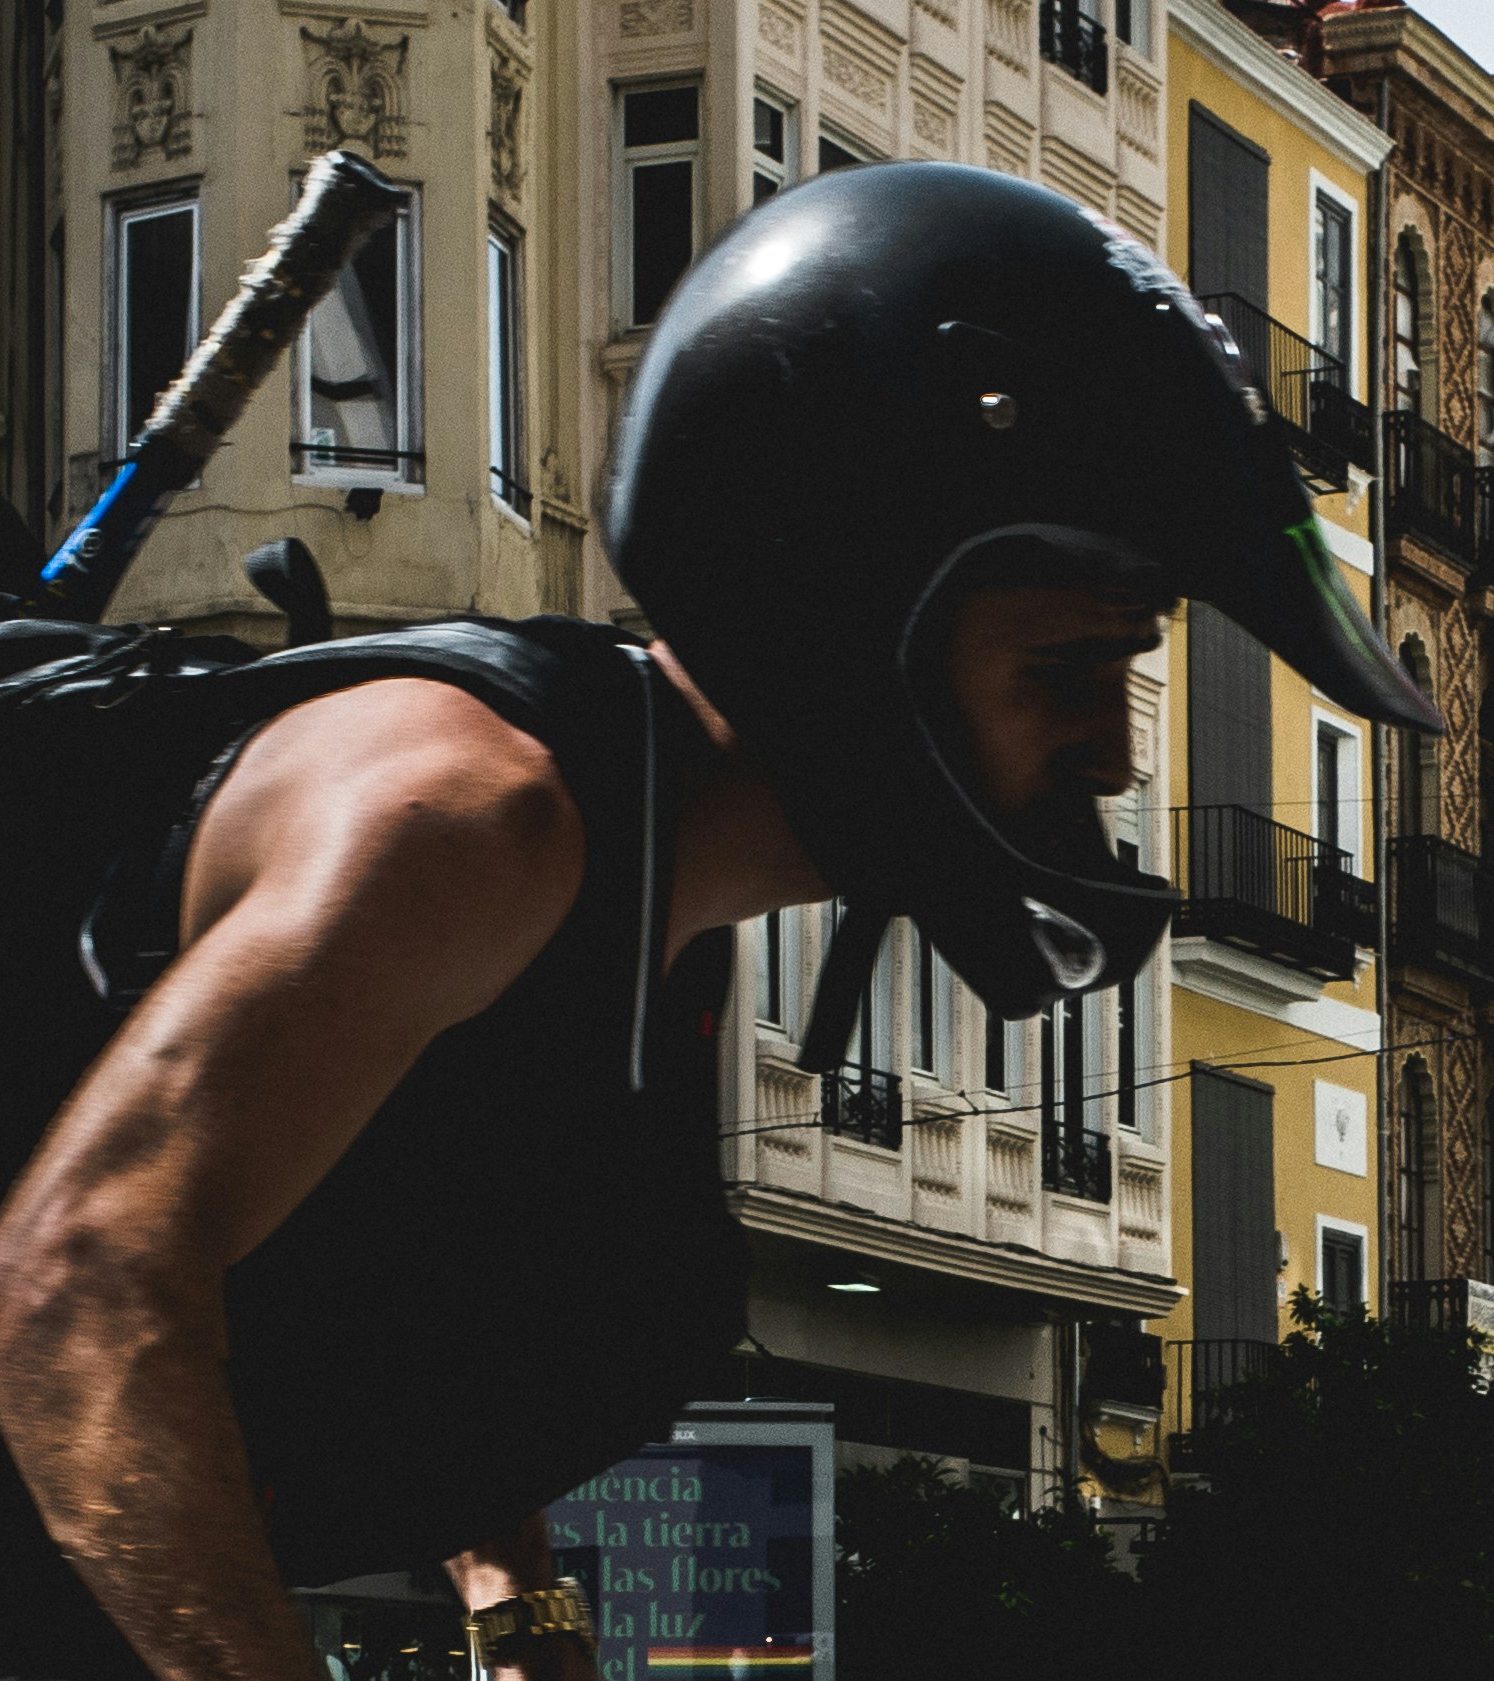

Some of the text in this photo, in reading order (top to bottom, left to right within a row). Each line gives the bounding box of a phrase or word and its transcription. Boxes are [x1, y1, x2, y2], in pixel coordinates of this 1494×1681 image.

[564, 1465, 703, 1502] alència
[595, 1509, 628, 1548] la
[642, 1511, 752, 1549] tierra
[602, 1555, 656, 1593] las
[670, 1554, 783, 1593] flores
[603, 1600, 707, 1639] la luz
